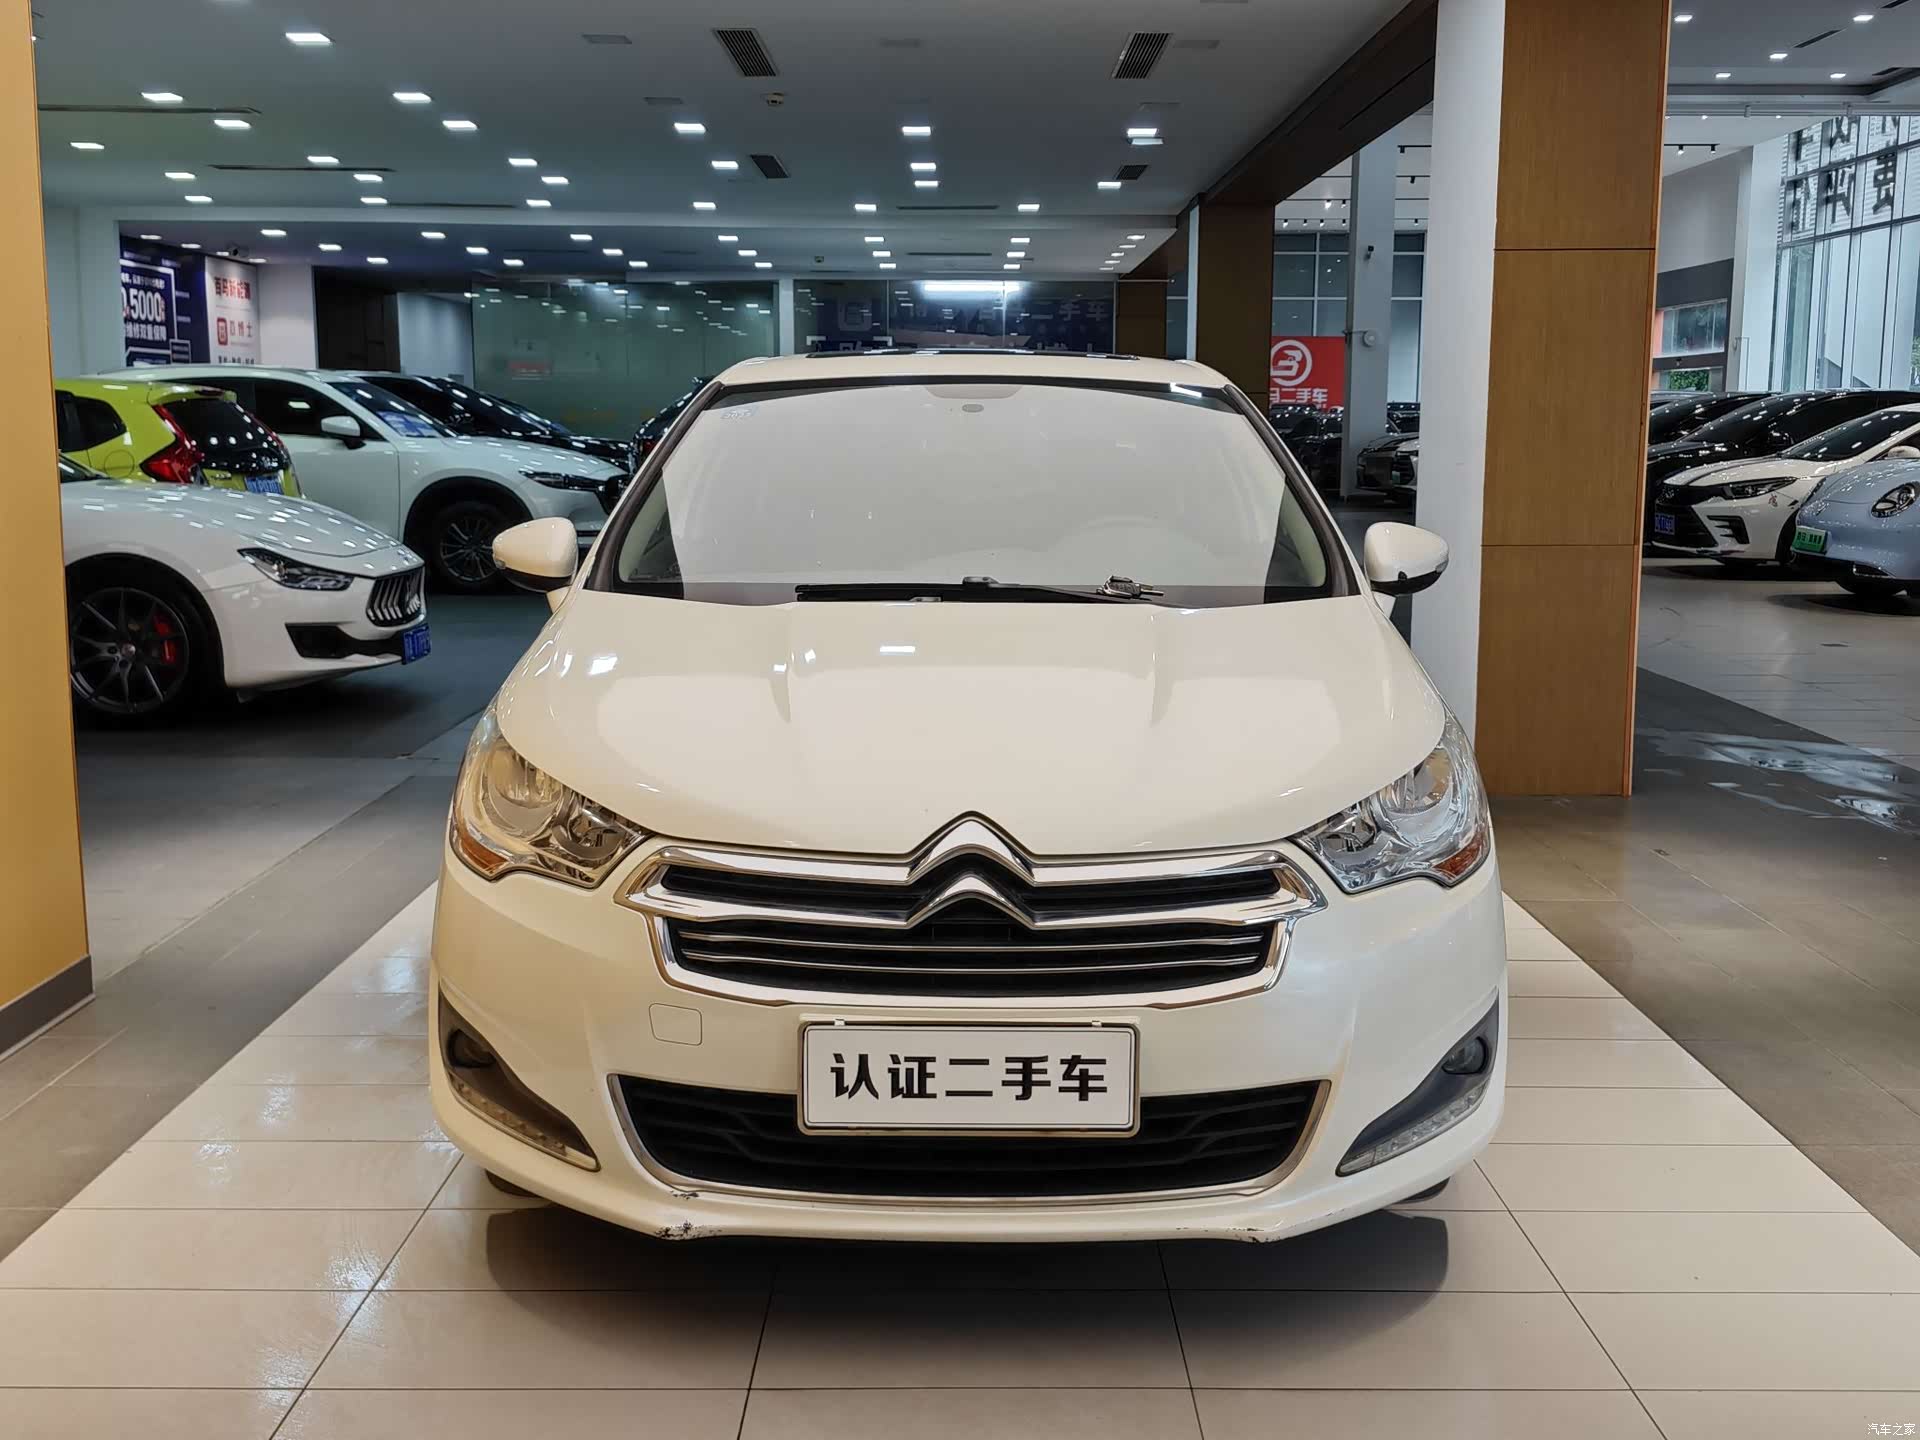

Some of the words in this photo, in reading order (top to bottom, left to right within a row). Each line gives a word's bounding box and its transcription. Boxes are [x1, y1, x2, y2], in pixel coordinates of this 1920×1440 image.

[830, 1053, 1108, 1102] 认证二手车
